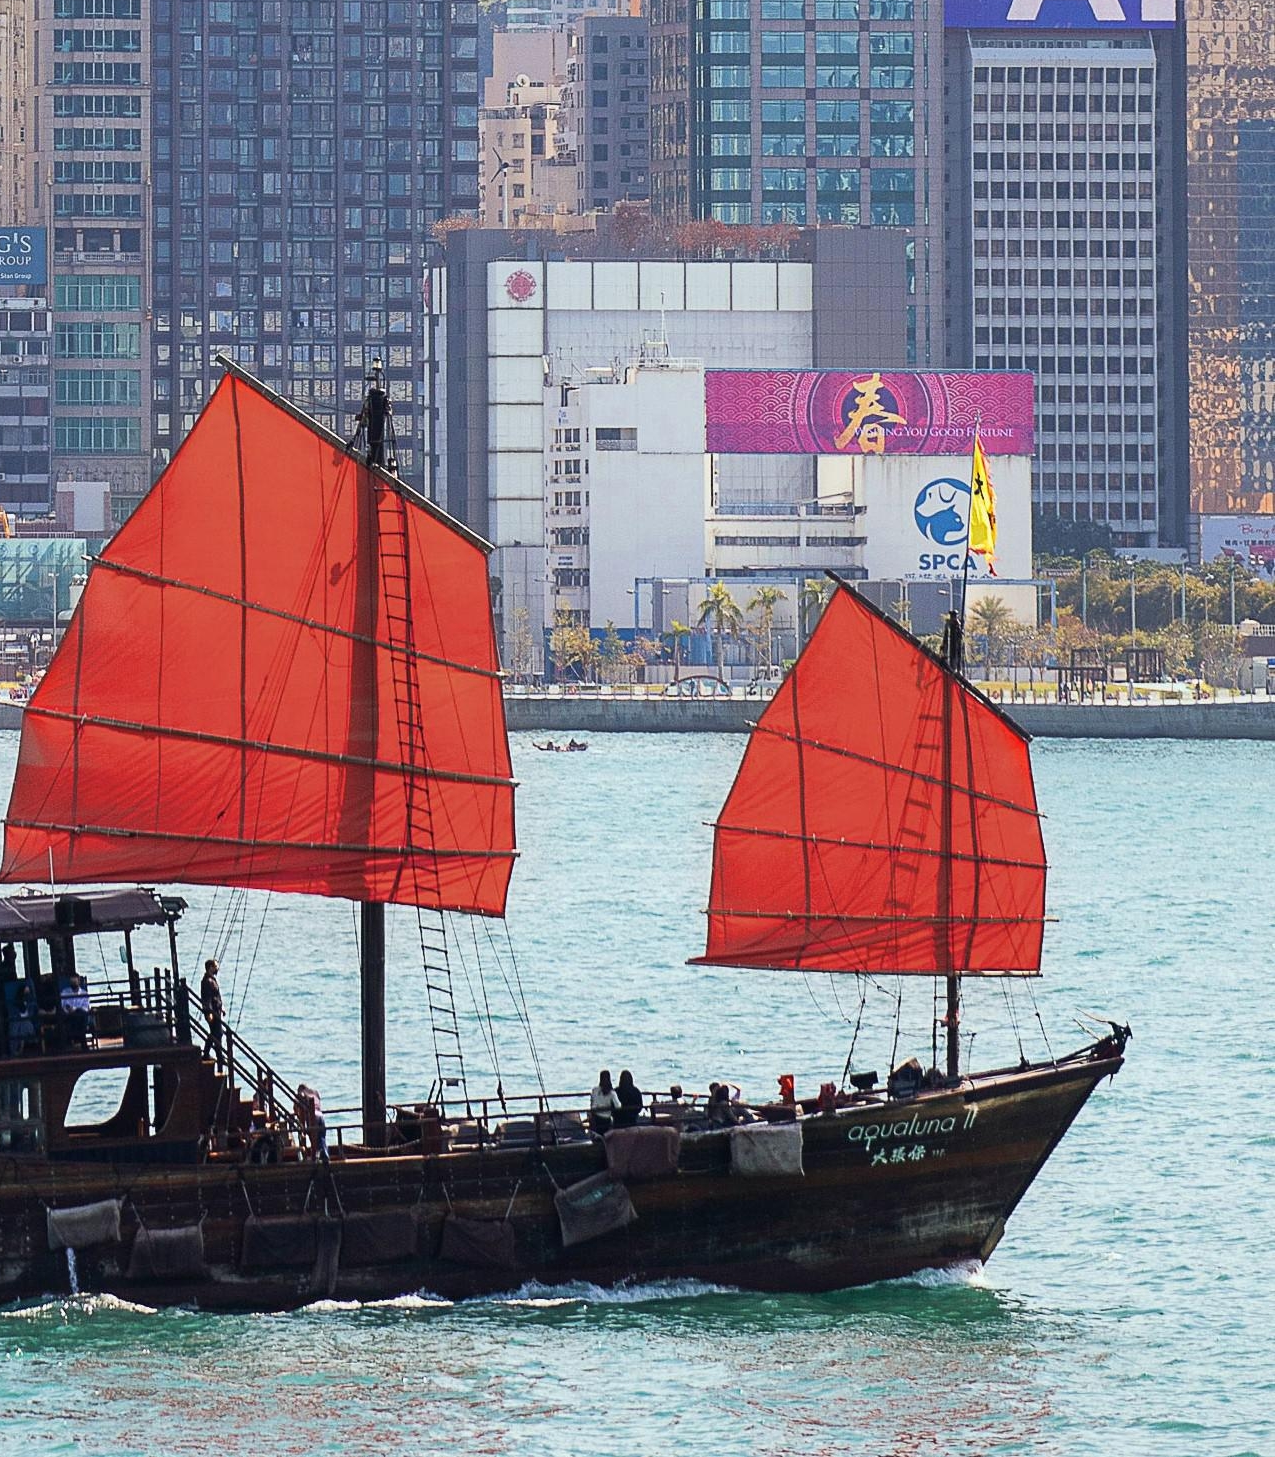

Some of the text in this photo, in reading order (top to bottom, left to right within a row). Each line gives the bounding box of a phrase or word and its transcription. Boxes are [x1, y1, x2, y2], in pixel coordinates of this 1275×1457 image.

[14, 272, 32, 280] Group
[834, 373, 908, 453] 春
[919, 553, 978, 571] SPCA
[848, 1112, 956, 1151] aqualuna
